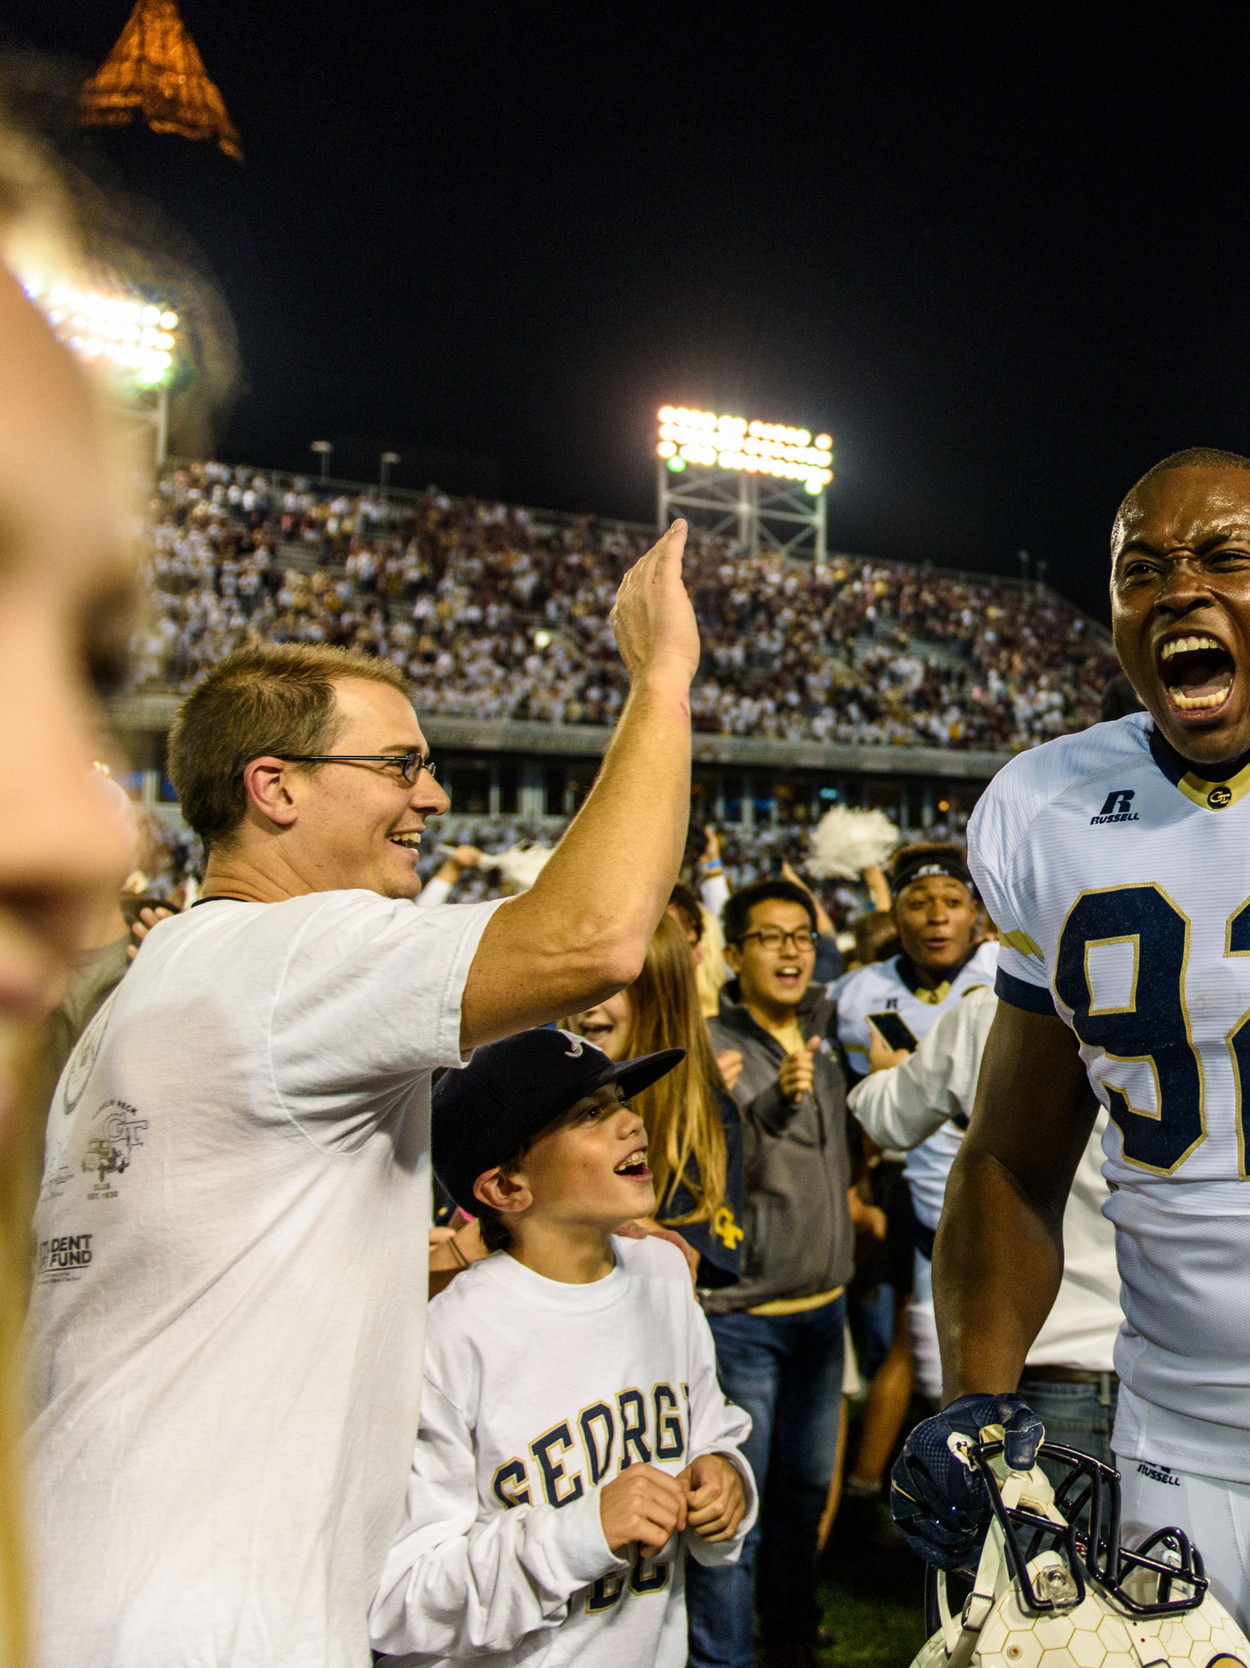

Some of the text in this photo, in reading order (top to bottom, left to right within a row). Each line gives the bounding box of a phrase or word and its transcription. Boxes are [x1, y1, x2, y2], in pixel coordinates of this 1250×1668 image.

[1210, 791, 1230, 804] GT
[1090, 812, 1140, 826] RUSSELL
[50, 1250, 92, 1267] FUND
[491, 1382, 689, 1511] GEORG
[1137, 1464, 1181, 1486] RUSSELL
